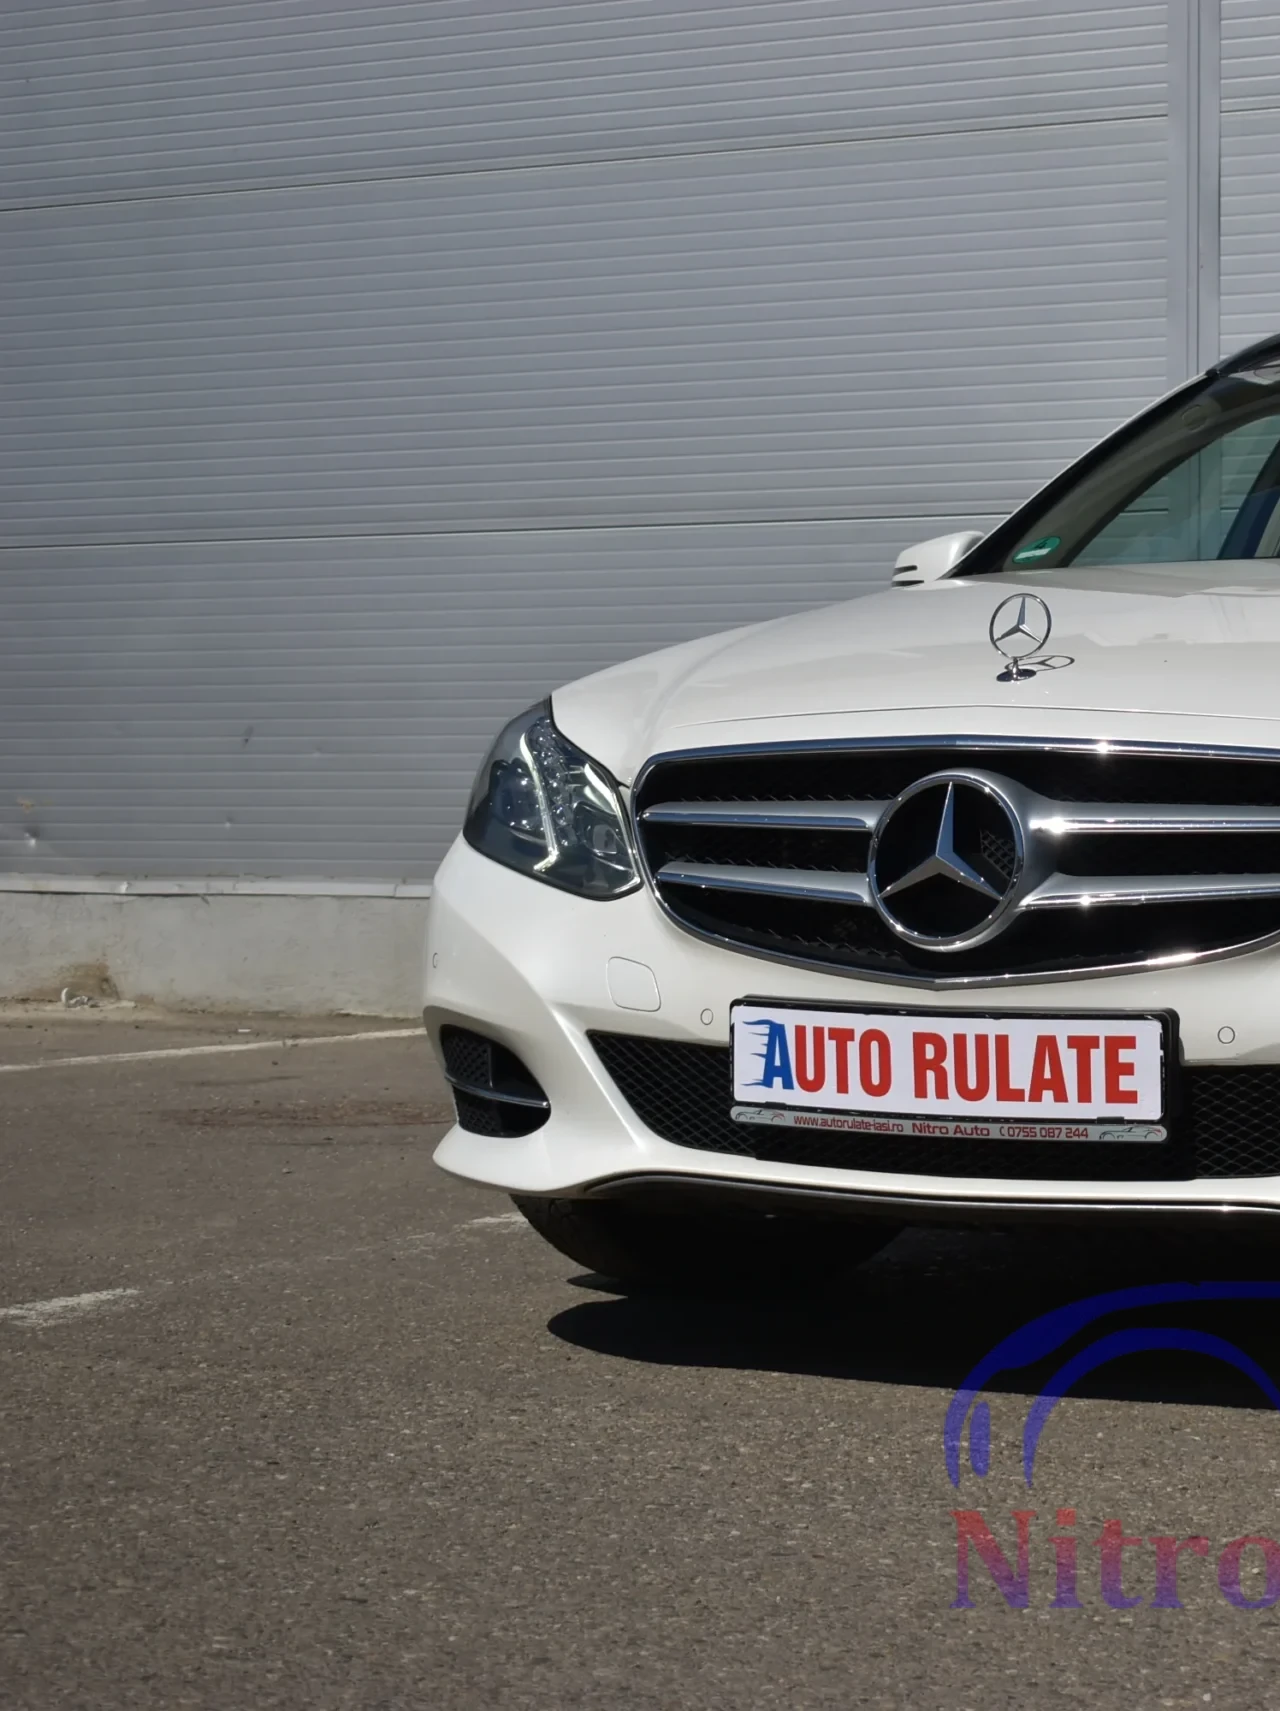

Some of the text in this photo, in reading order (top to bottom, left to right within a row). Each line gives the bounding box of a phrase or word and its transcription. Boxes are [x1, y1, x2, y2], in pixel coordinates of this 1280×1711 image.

[741, 1019, 1138, 1104] AUTO RULATE
[793, 1115, 1089, 1139] www.autorulate-iasi.ro Nitro Auto 0755 087 244
